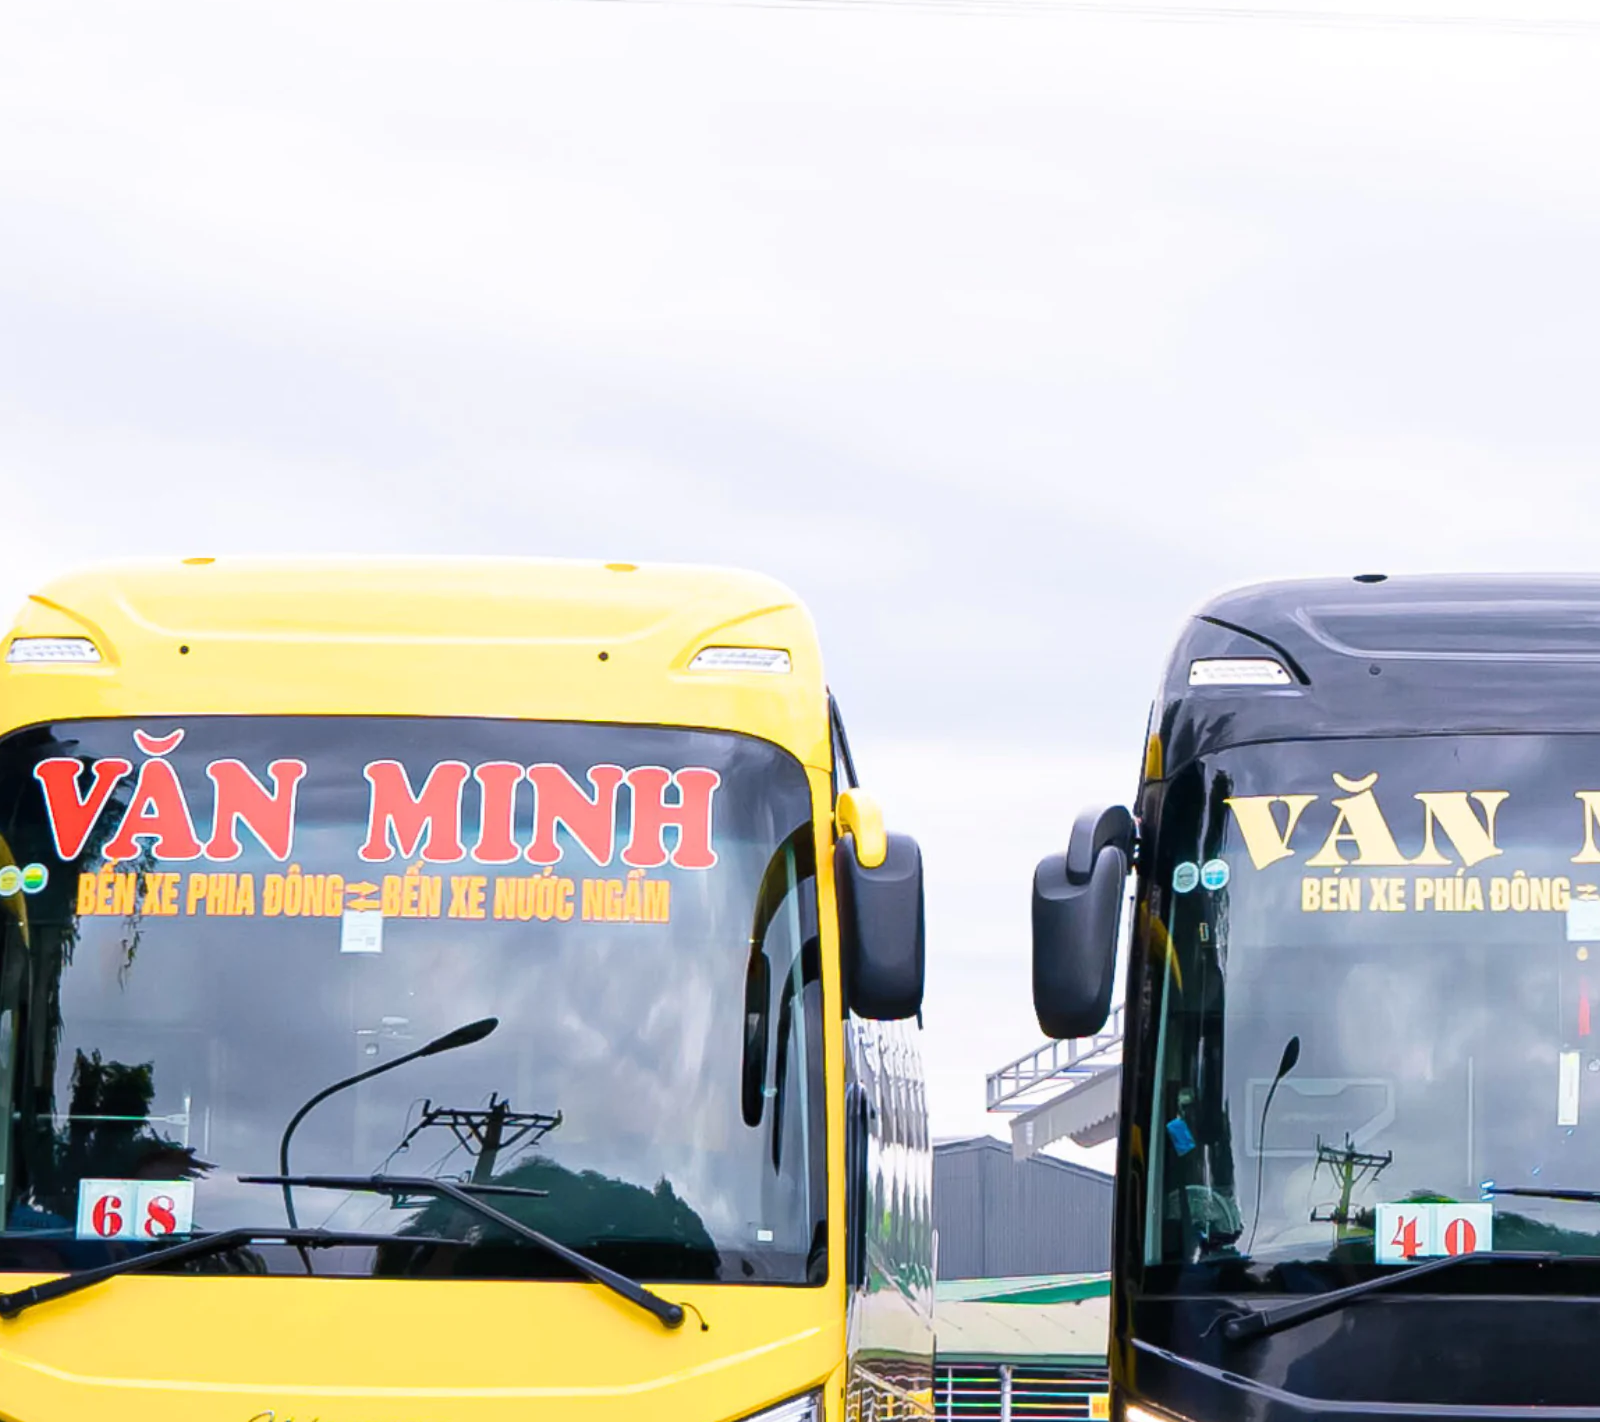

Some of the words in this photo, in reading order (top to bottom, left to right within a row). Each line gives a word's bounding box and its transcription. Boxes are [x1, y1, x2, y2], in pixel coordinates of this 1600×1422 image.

[32, 728, 307, 862] VĂN
[358, 759, 722, 870] MINH
[1223, 772, 1511, 870] VĂN
[76, 857, 136, 916] BẾN
[141, 873, 181, 916] XE
[263, 863, 344, 916] ĐÔNG
[382, 860, 442, 918] BẾN
[448, 875, 487, 919] XE
[493, 866, 575, 921] NƯỚC
[1369, 877, 1406, 912] XE
[1415, 868, 1484, 912] PHÍA
[1489, 870, 1570, 912] ĐÔNG
